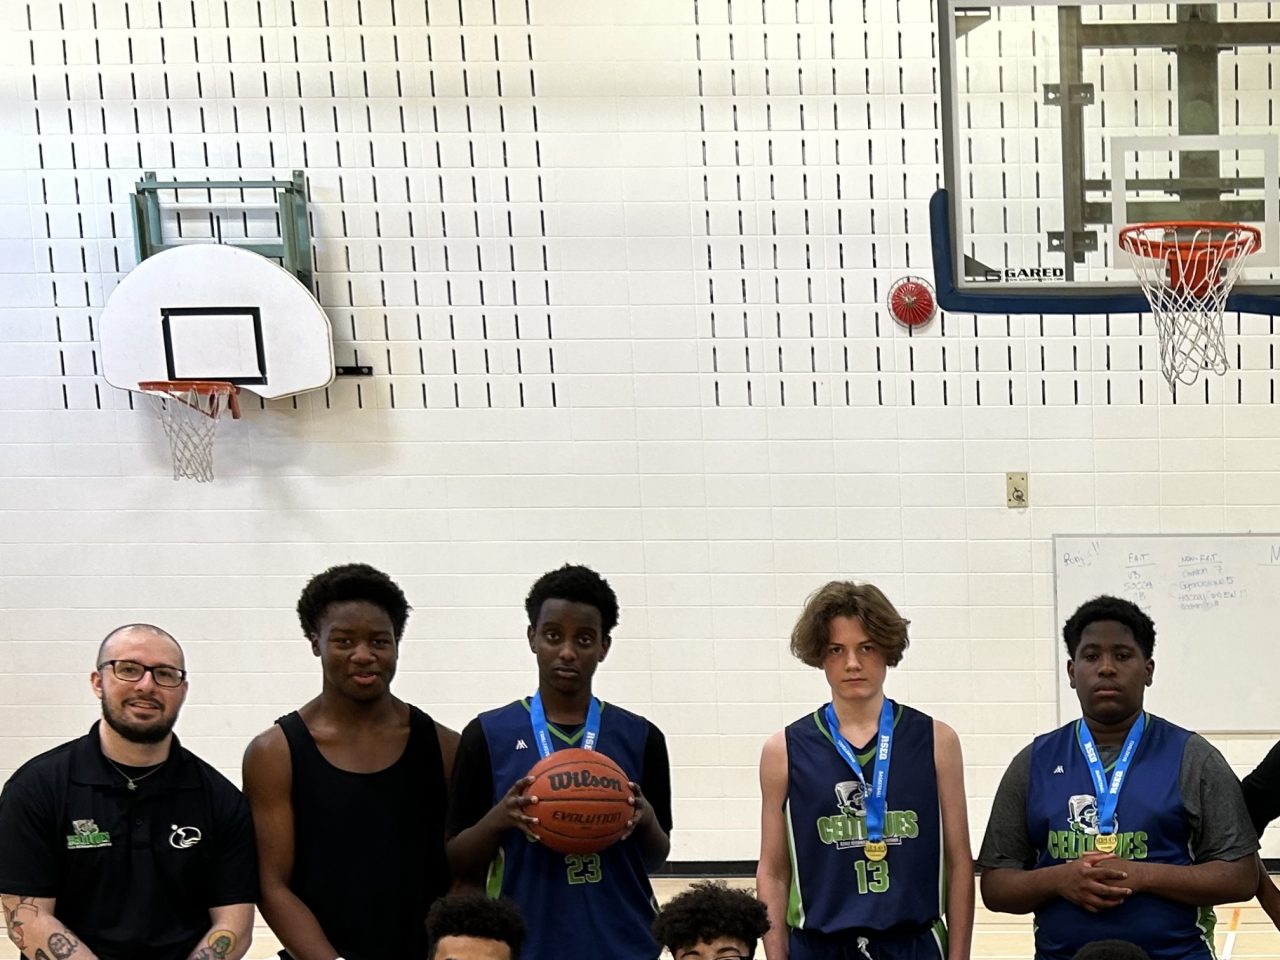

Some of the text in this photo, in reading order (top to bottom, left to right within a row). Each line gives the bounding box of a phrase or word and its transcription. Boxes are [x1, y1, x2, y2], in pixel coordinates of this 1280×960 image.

[1004, 268, 1064, 278] GARED
[584, 732, 595, 750] RSE
[879, 735, 890, 760] RSEQ
[548, 770, 622, 792] Wilson
[552, 811, 622, 825] EVOLUTION
[565, 853, 602, 885] 23
[854, 859, 890, 895] 13
